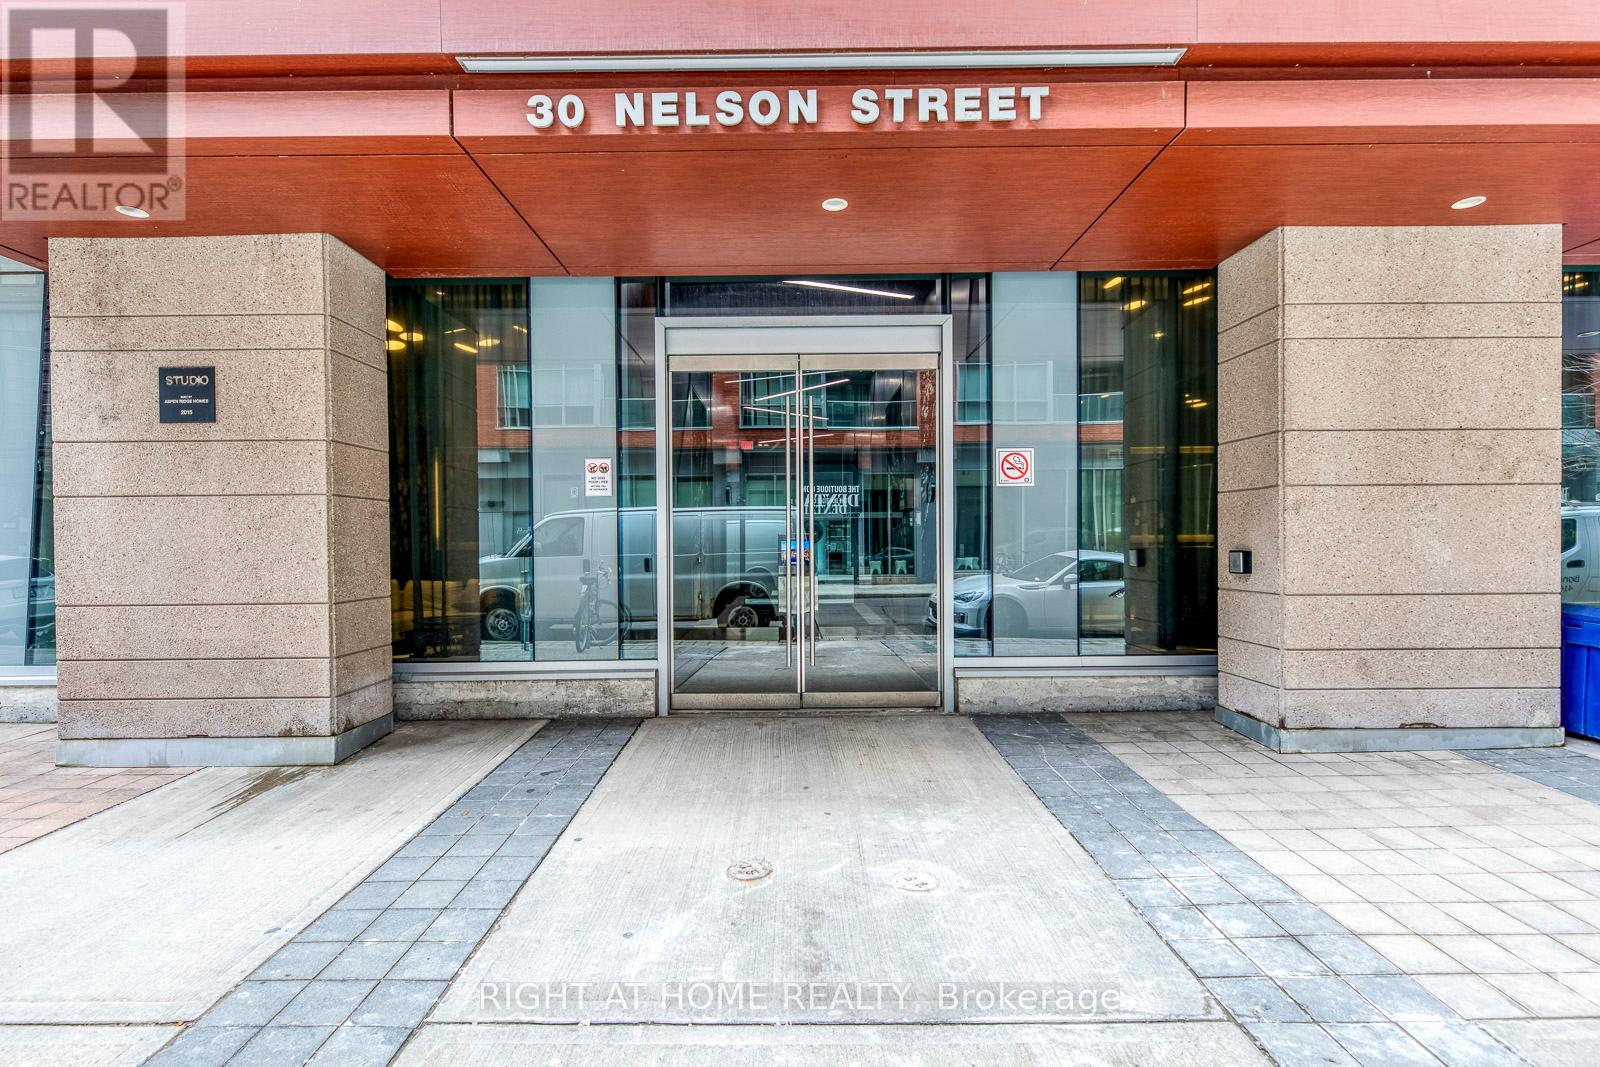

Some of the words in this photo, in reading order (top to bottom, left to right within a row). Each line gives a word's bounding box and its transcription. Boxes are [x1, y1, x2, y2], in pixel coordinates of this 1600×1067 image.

[526, 94, 585, 128] 30
[614, 89, 818, 127] NELSON
[850, 86, 1050, 125] STREET
[165, 375, 209, 385] STUDIO
